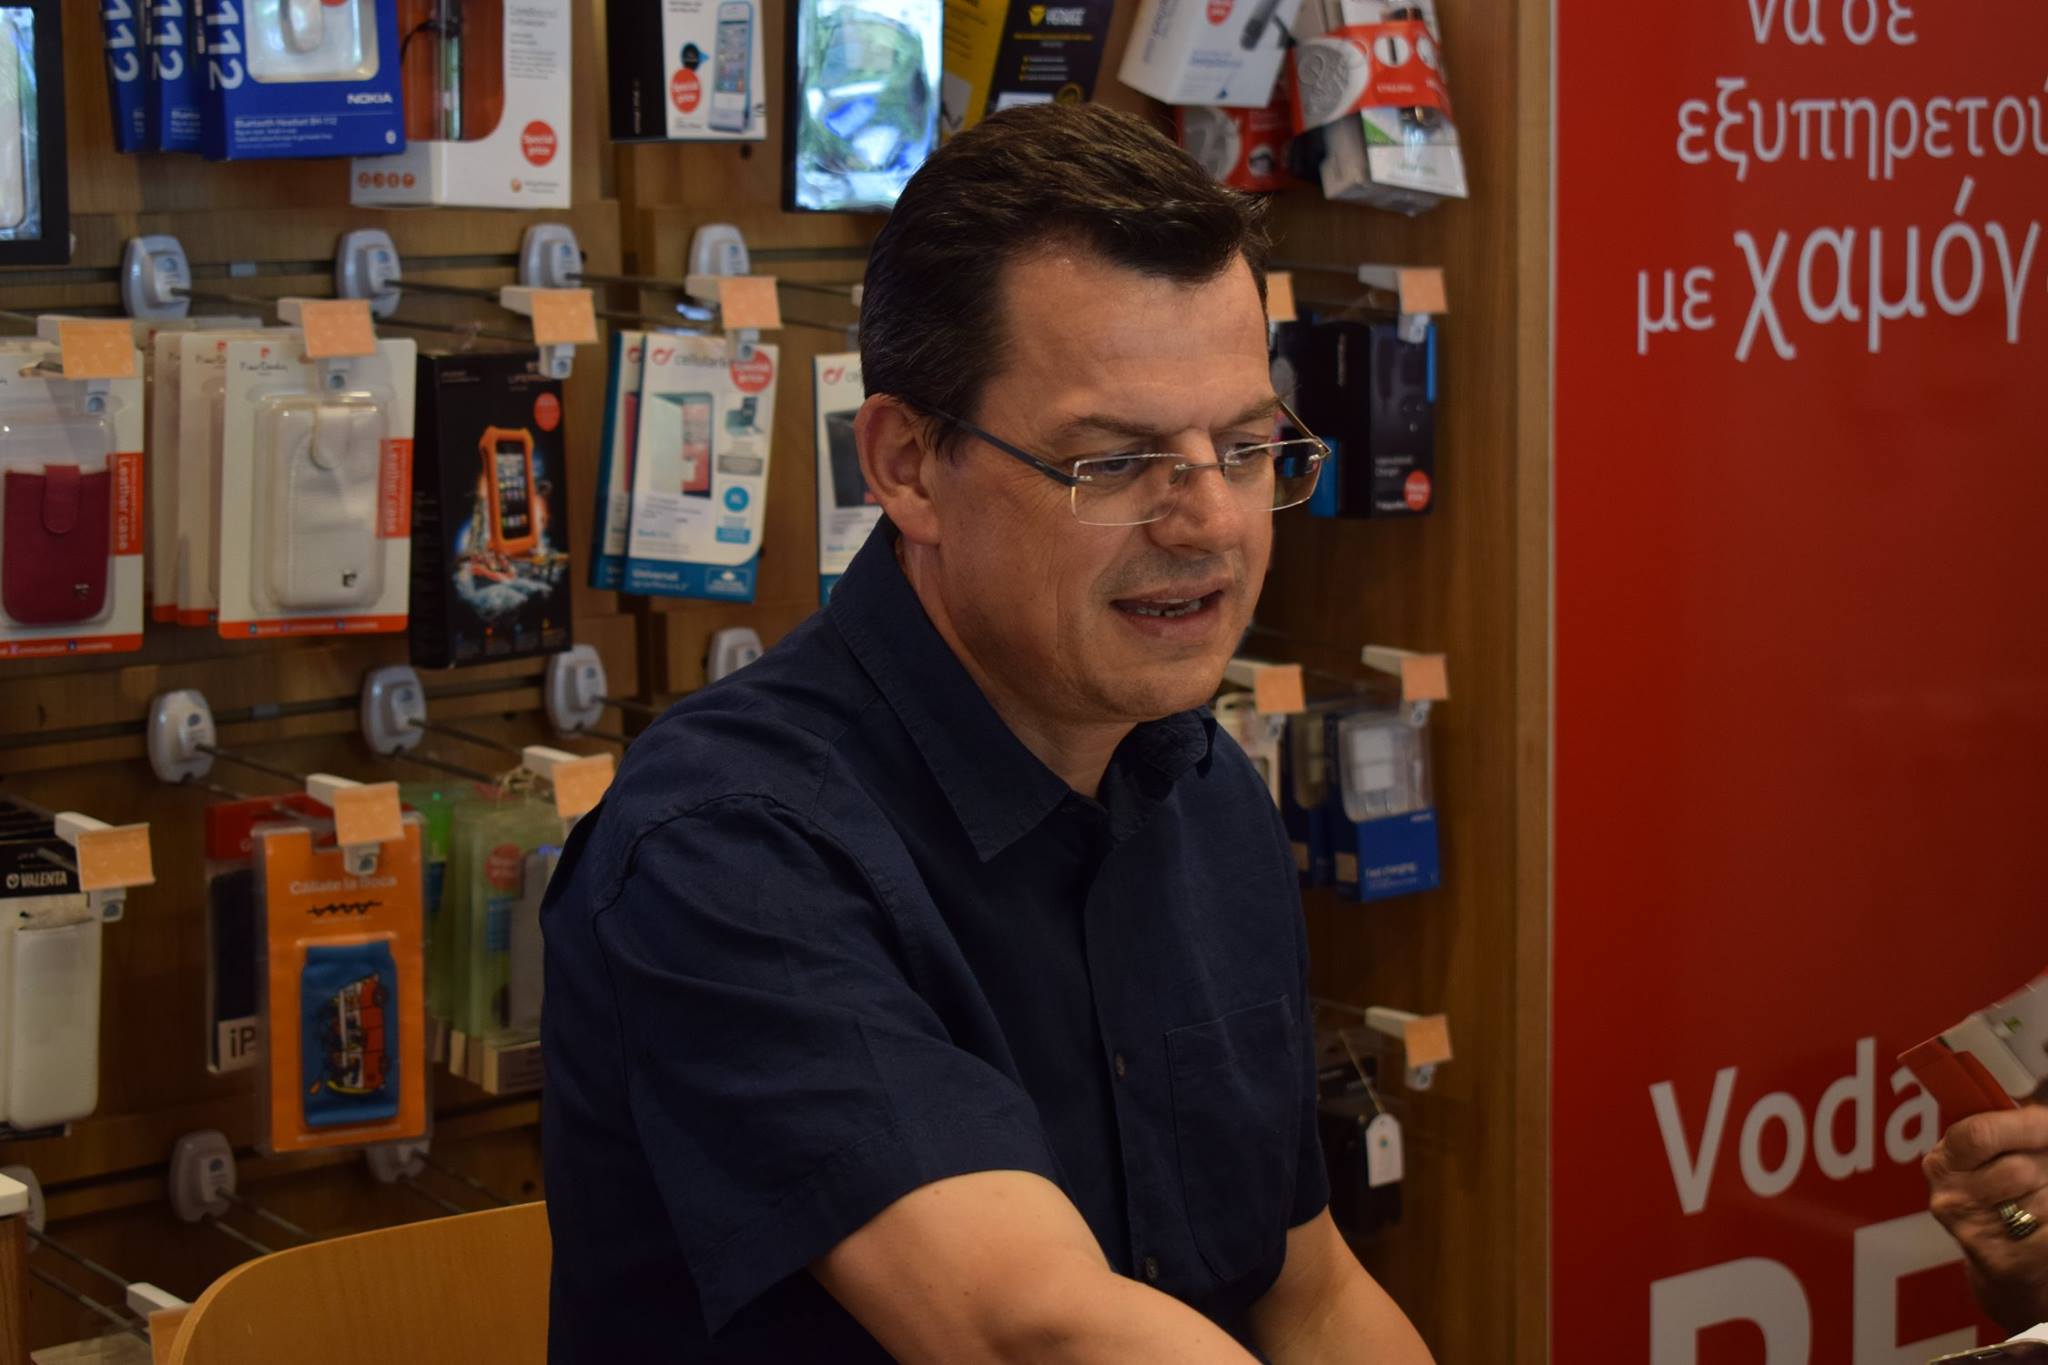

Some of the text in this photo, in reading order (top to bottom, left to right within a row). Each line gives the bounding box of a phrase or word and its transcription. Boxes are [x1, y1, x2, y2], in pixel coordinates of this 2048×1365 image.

[347, 92, 393, 104] NOKIA
[1637, 176, 2048, 362] με χαμόγ
[118, 458, 130, 550] Leather case
[20, 870, 68, 888] VALENTA
